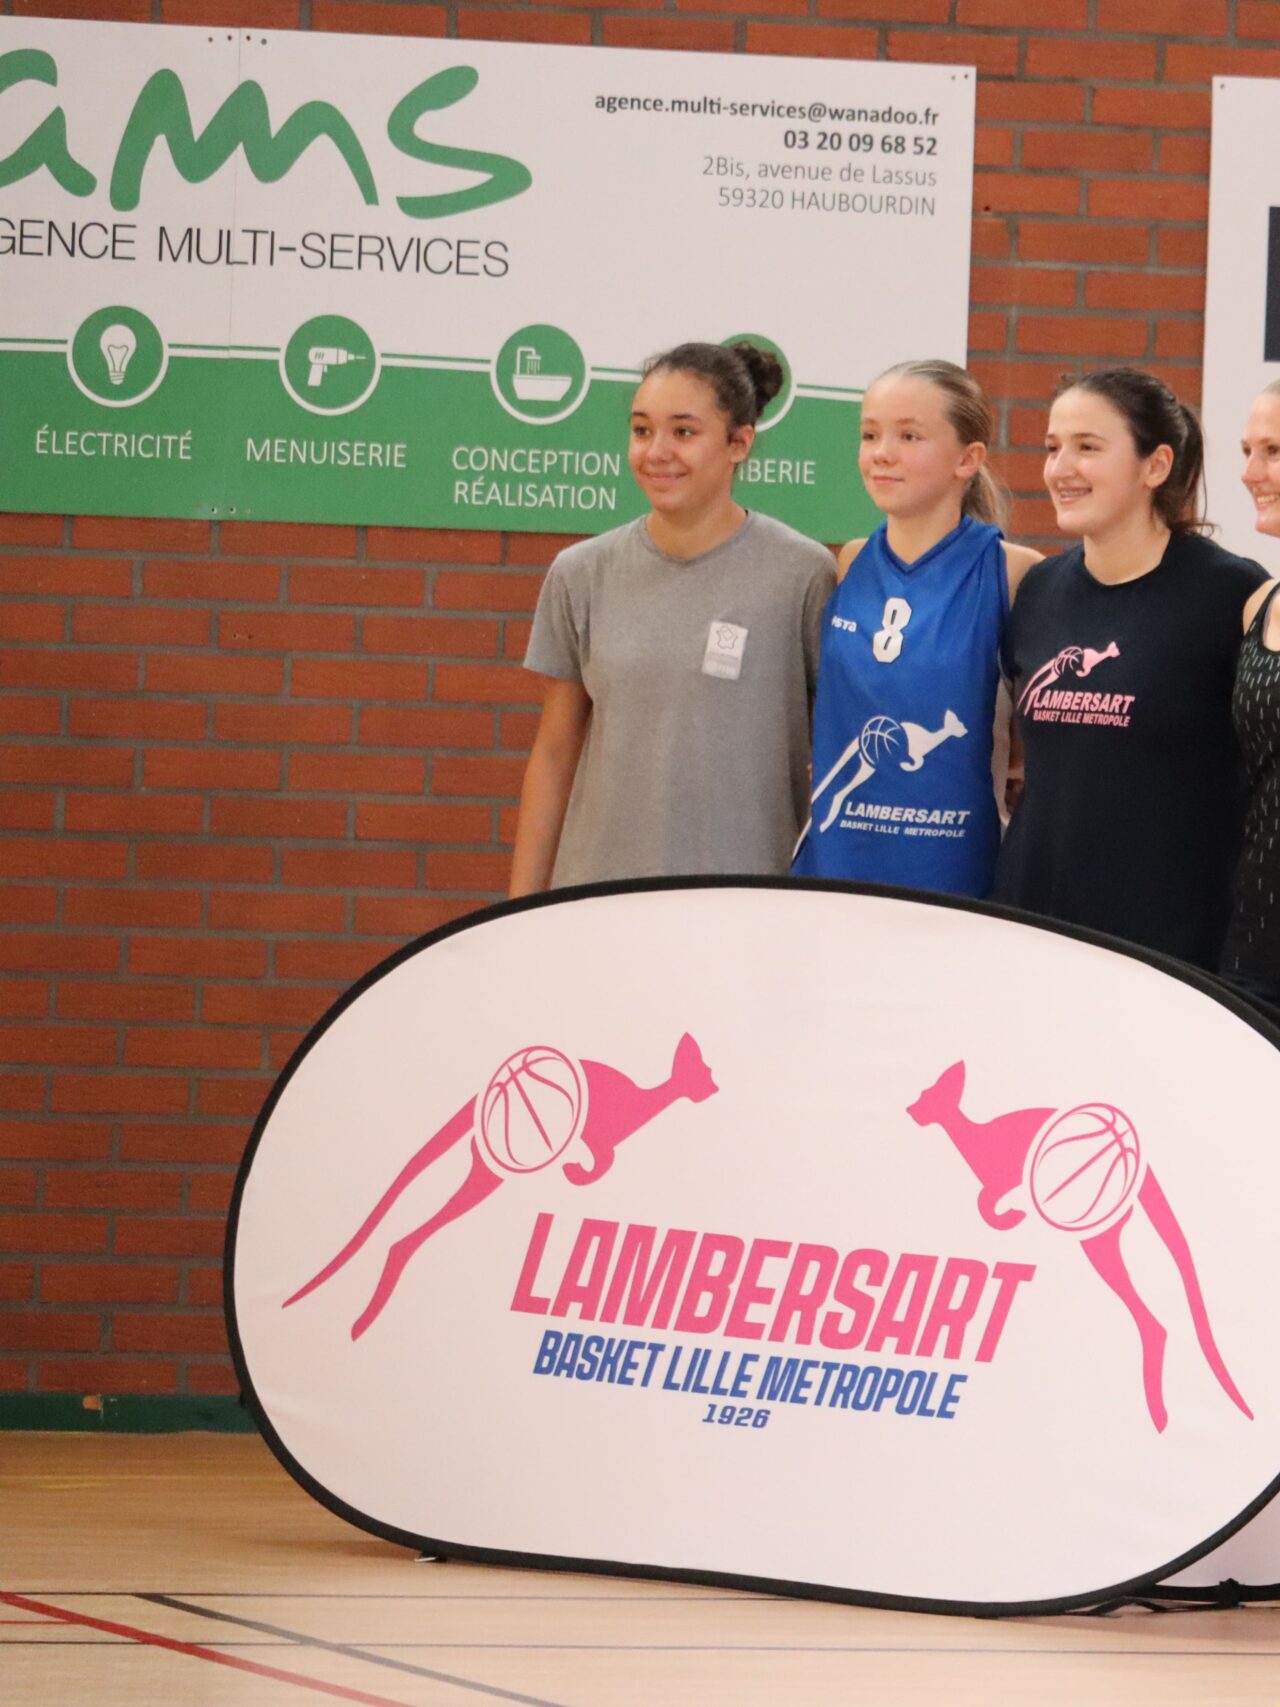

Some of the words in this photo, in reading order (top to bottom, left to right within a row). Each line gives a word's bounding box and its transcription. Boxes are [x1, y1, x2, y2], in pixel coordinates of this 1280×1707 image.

[594, 95, 940, 126] agence.multi-services@wanadoo.fr
[784, 129, 809, 150] 03
[816, 131, 842, 152] 20
[848, 133, 874, 154] 09
[881, 135, 906, 155] 68
[912, 136, 938, 156] 52
[702, 155, 750, 179] 2Bis,
[757, 162, 832, 183] avenue
[839, 162, 865, 183] de
[872, 165, 937, 187] Lassus
[718, 187, 784, 210] 59320
[790, 190, 936, 217] HAUBOURDIN
[0, 217, 137, 261] GENCE
[158, 225, 509, 278] MULTI-SERVICES
[35, 423, 193, 461] ÉLECTRICITÉ
[245, 437, 407, 470] MENUISERIE
[452, 446, 621, 477] CONCEPTION
[739, 459, 817, 485] BERIE
[453, 475, 617, 511] RÉALISATION
[872, 597, 912, 664] 8
[1033, 687, 1135, 715] LAMBERSART
[1033, 710, 1060, 723] BASKET
[1060, 711, 1082, 724] LILLE
[1082, 712, 1131, 728] METROPOLE
[840, 819, 873, 831] BASKET
[874, 823, 900, 835] LILLE
[903, 826, 966, 838] METROPOLE
[845, 801, 970, 825] LAMBERSART
[510, 1212, 1037, 1364] LAMBERSART
[533, 1328, 667, 1388] BASKET
[662, 1345, 760, 1399] LILLE
[757, 1356, 968, 1420] METROPOLE
[702, 1402, 771, 1429] 1926
